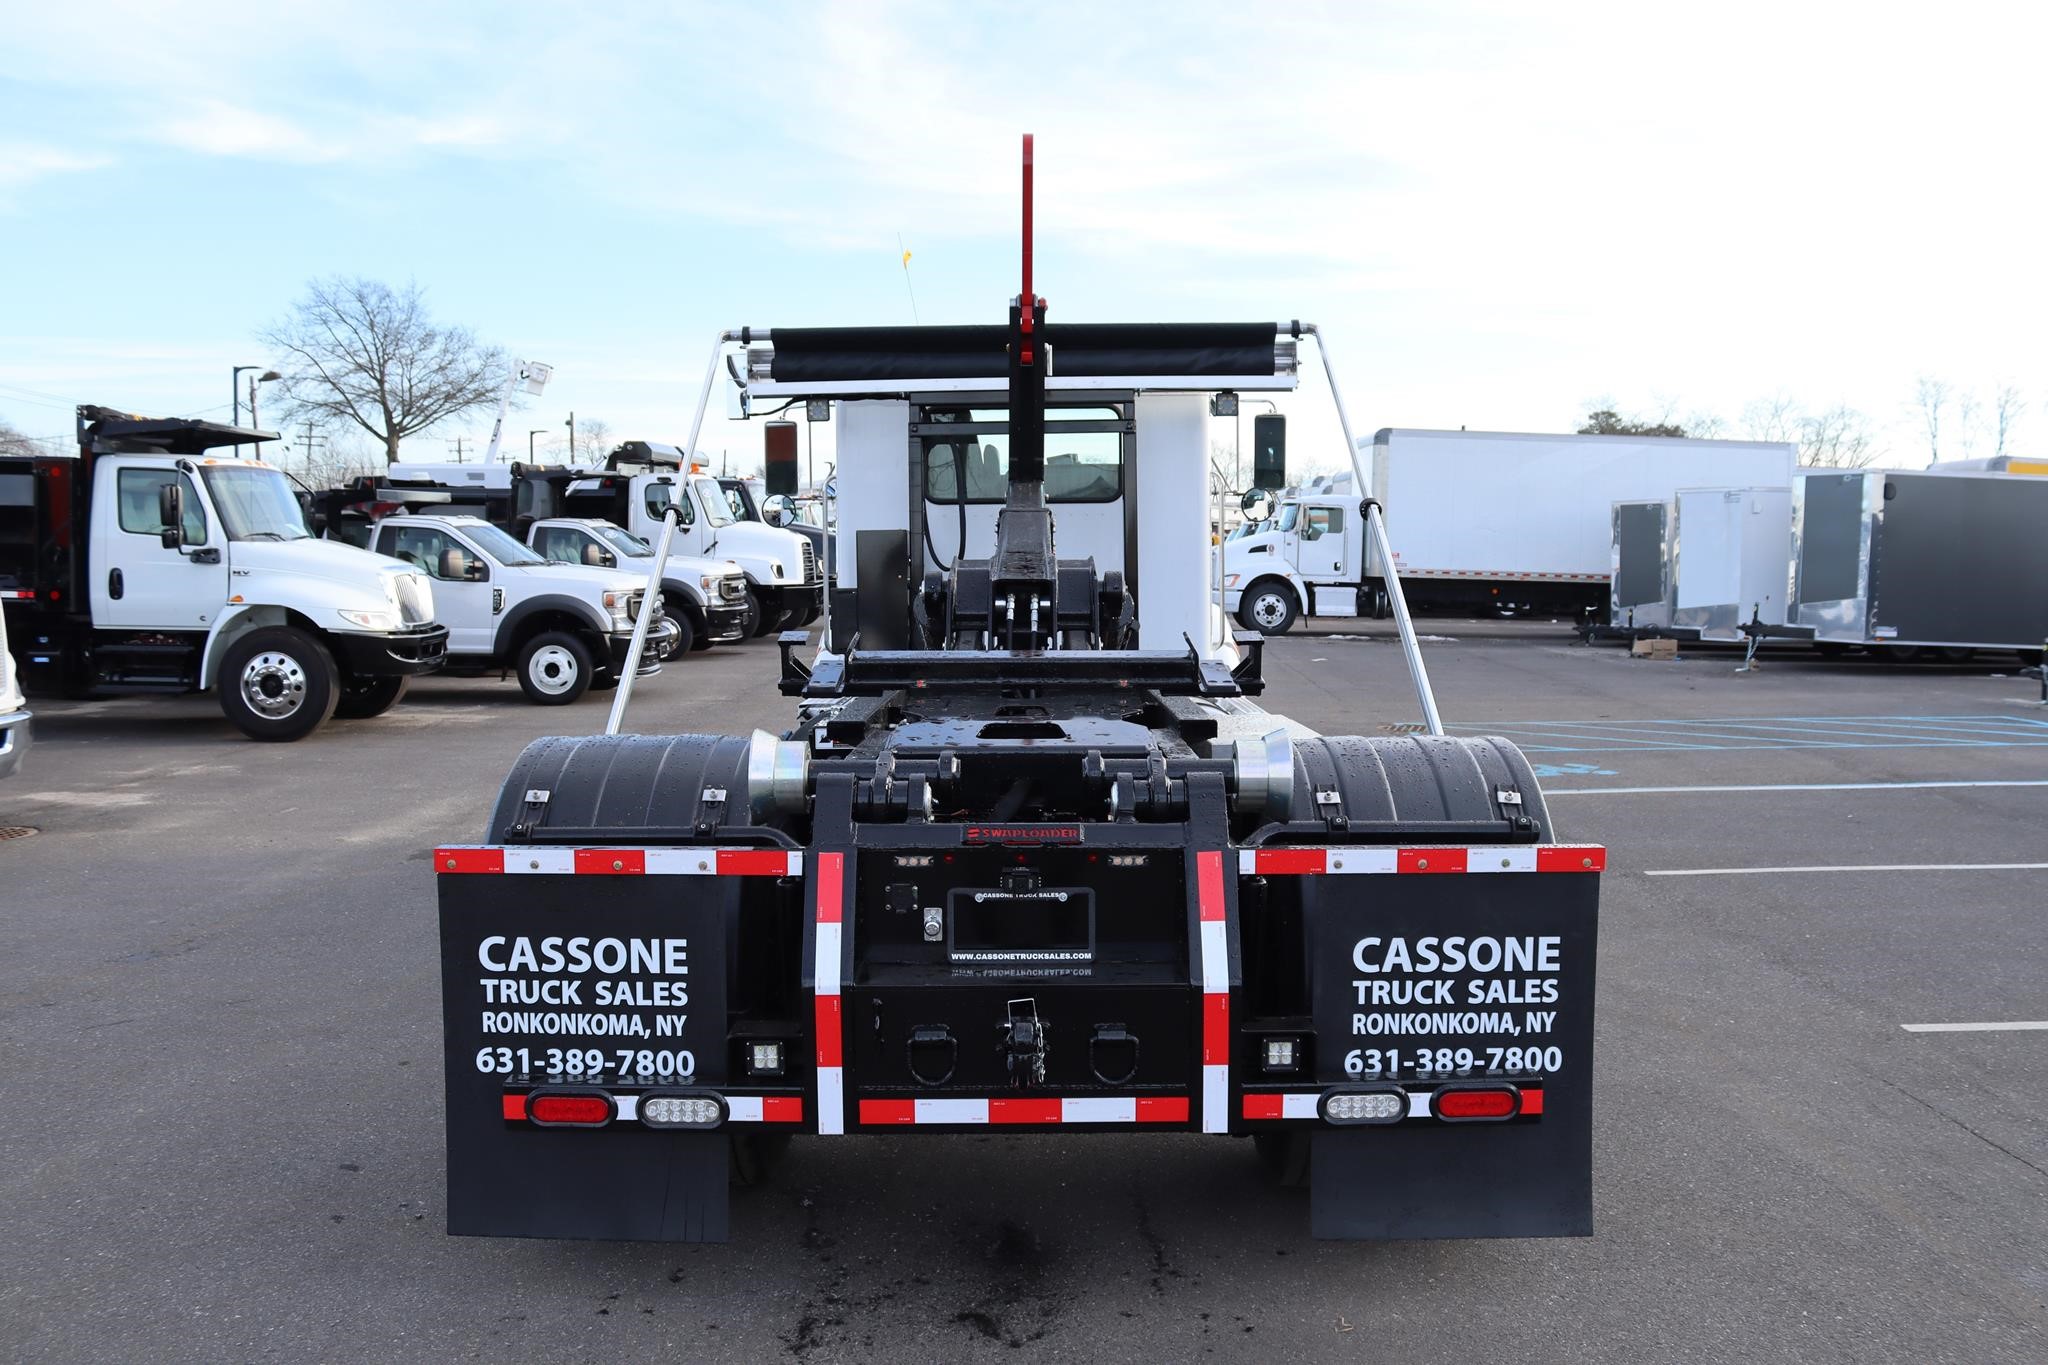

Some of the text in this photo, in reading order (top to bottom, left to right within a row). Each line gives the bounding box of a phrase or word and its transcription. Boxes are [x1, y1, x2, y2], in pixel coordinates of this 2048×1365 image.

[983, 828, 1078, 838] SWAPLOADER
[478, 935, 689, 975] CASSONE
[951, 952, 1092, 960] WWW.CASSONETRUCKSALES.COM
[1352, 936, 1561, 974] CASSONE
[479, 978, 689, 1007] TRUCK SALES
[1352, 978, 1559, 1005] TRUCK SALES
[482, 1011, 688, 1040] RONKONKOMA, NY
[1352, 1011, 1557, 1037] RONKONKOMA, NY
[475, 1046, 695, 1077] 631-389-7800
[1344, 1046, 1563, 1074] 631-389-7800
